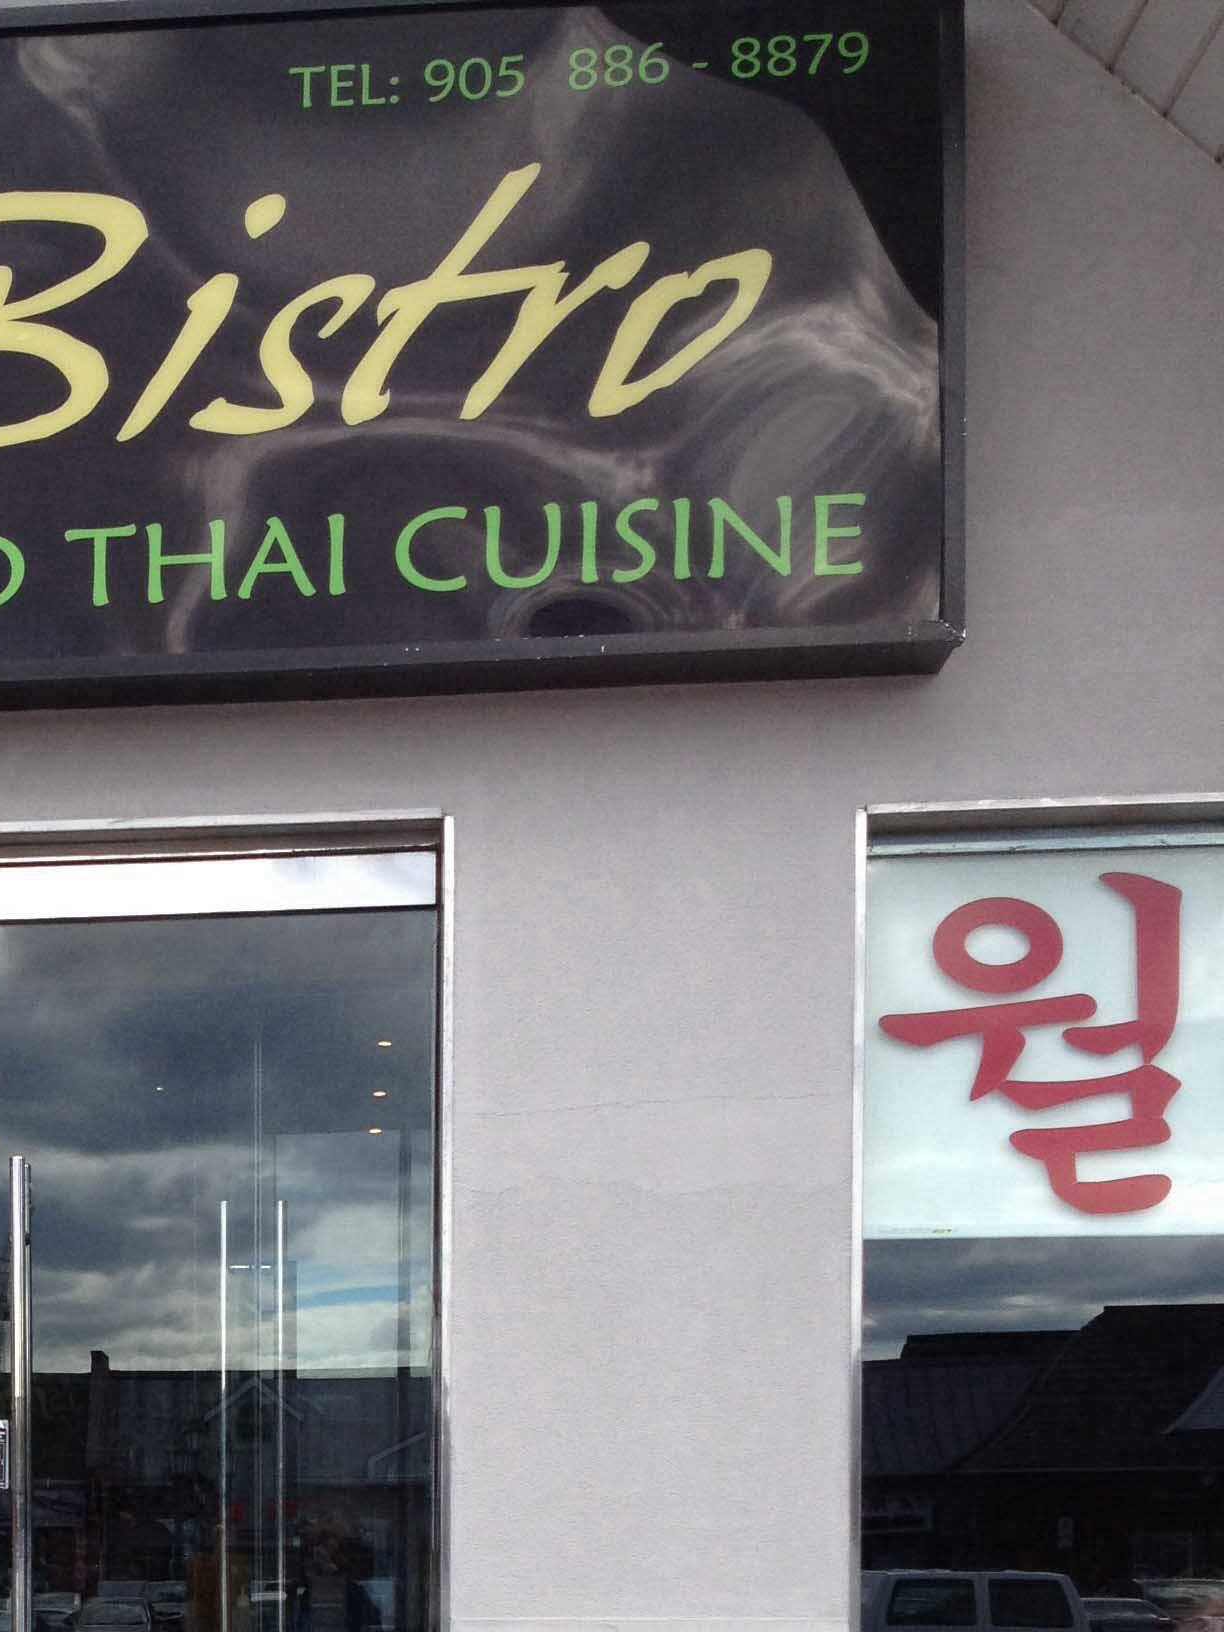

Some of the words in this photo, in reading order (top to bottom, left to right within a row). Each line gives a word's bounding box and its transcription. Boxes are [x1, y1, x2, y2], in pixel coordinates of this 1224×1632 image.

[289, 63, 402, 109] TEL:
[423, 54, 526, 103] 905
[567, 42, 671, 92] 886
[730, 31, 870, 79] 8879
[67, 513, 345, 608] THAI
[394, 491, 867, 592] CUISINE
[879, 872, 1182, 1215] 월
